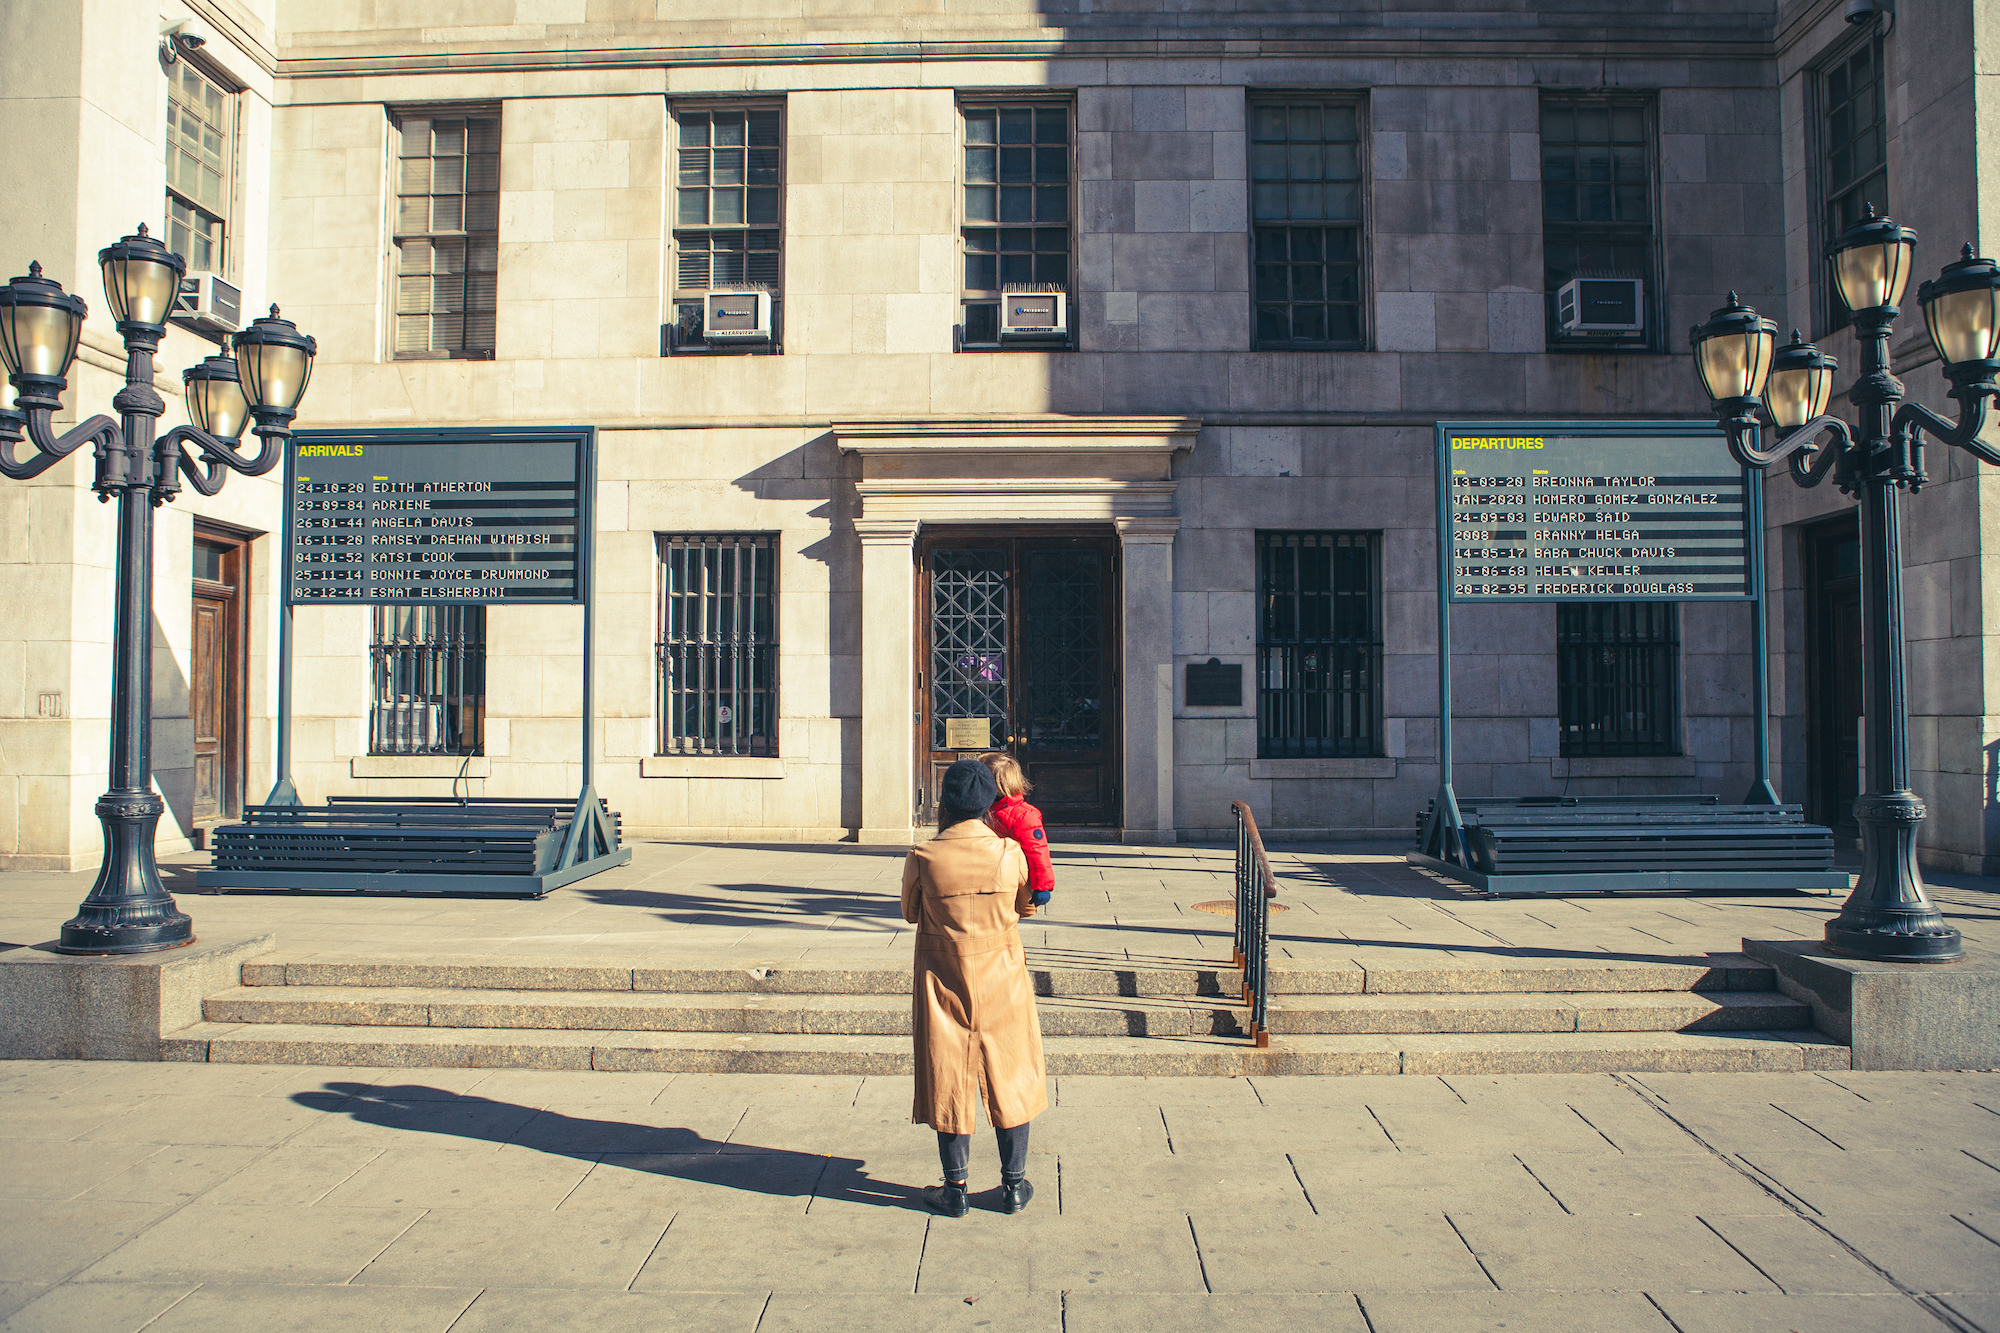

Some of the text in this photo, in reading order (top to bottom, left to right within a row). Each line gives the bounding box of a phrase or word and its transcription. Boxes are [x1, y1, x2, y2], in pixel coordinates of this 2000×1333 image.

[1452, 438, 1544, 449] DEPARTURES
[299, 445, 363, 456] ARRIVALS
[1453, 477, 1656, 487] 13-03-20 BREONNA TAYLOR
[297, 482, 491, 493] 24-10-20 EDITH ATHERTON
[1454, 494, 1718, 504] JAN-2020 HOMERO GOMEZ GONZALEZ
[297, 500, 431, 510] 29-09-84 ADRIENE
[1454, 512, 1630, 522] 24-09-03 EDWARD SAID
[297, 517, 473, 528] 26-01-44 ANGELA DAVIS
[296, 534, 550, 545] 16-11-20 RAMSEY DAEHAN WIMBISH
[1454, 530, 1640, 540] 2008 GRANNY HELGA
[296, 552, 456, 562] 04-01-52 KATSI COOK
[1455, 548, 1675, 558] 14-05-17 BABA CHUCK DAVIS
[295, 570, 550, 580] 25-11-14 BONNIE JOYCE DRUMMOND
[1456, 566, 1641, 576] 01-06-68 HELEN KELLER
[295, 588, 505, 597] 02-12-44 ESMAT ELSHERBINI
[1456, 583, 1694, 594] 20-02-95 FREDERICK DOUGLASS
